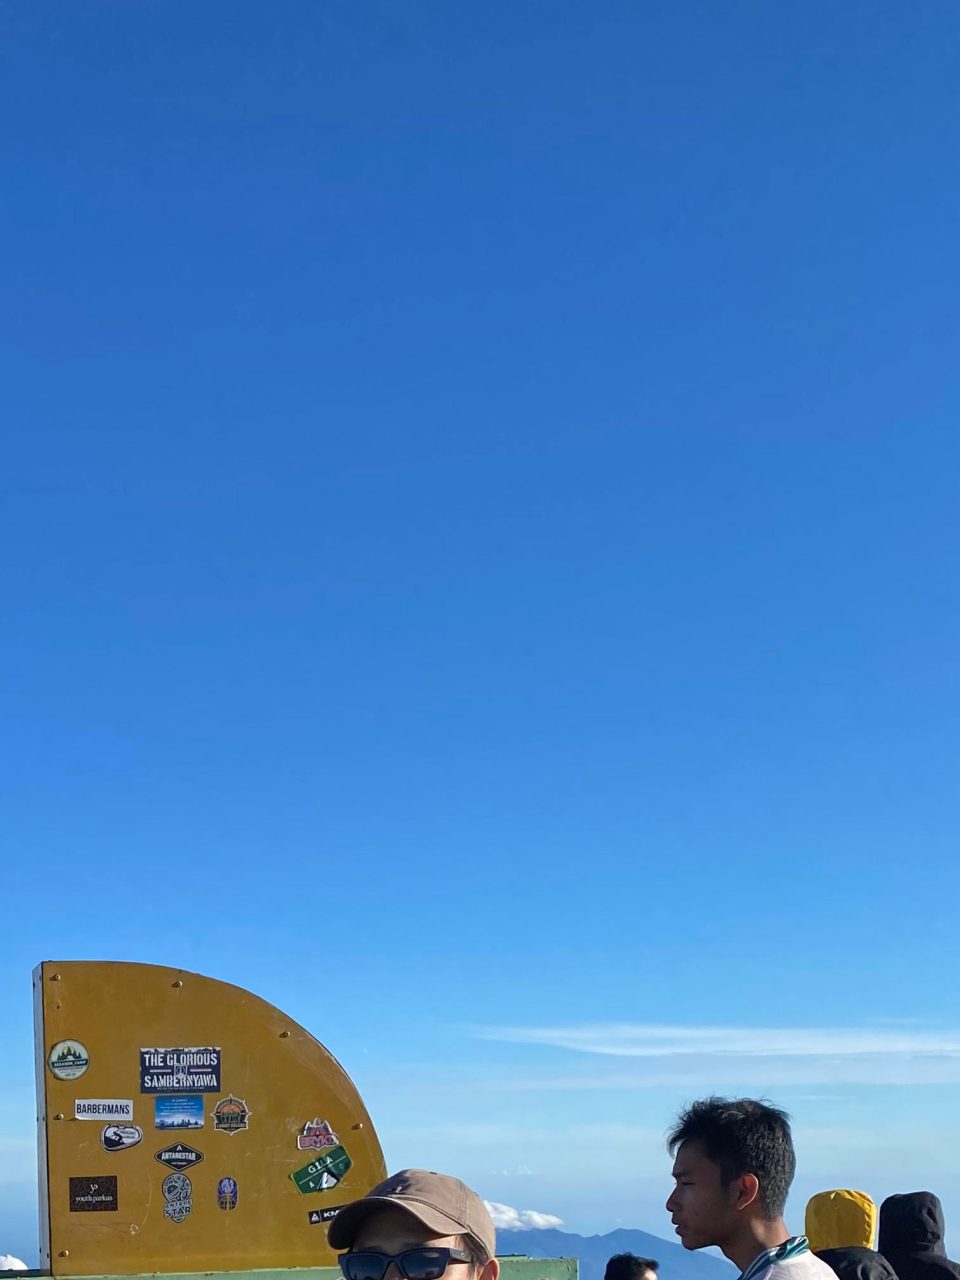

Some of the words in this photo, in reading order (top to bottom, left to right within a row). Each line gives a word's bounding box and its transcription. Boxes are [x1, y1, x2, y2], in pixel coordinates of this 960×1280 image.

[144, 1054, 164, 1066] THE
[166, 1053, 218, 1066] GLORIOUS
[144, 1074, 218, 1088] SAMBERNYAWA
[76, 1103, 130, 1115] BARBERMANS
[161, 1152, 196, 1161] ANTARESTAR
[166, 1206, 191, 1218] STAR
